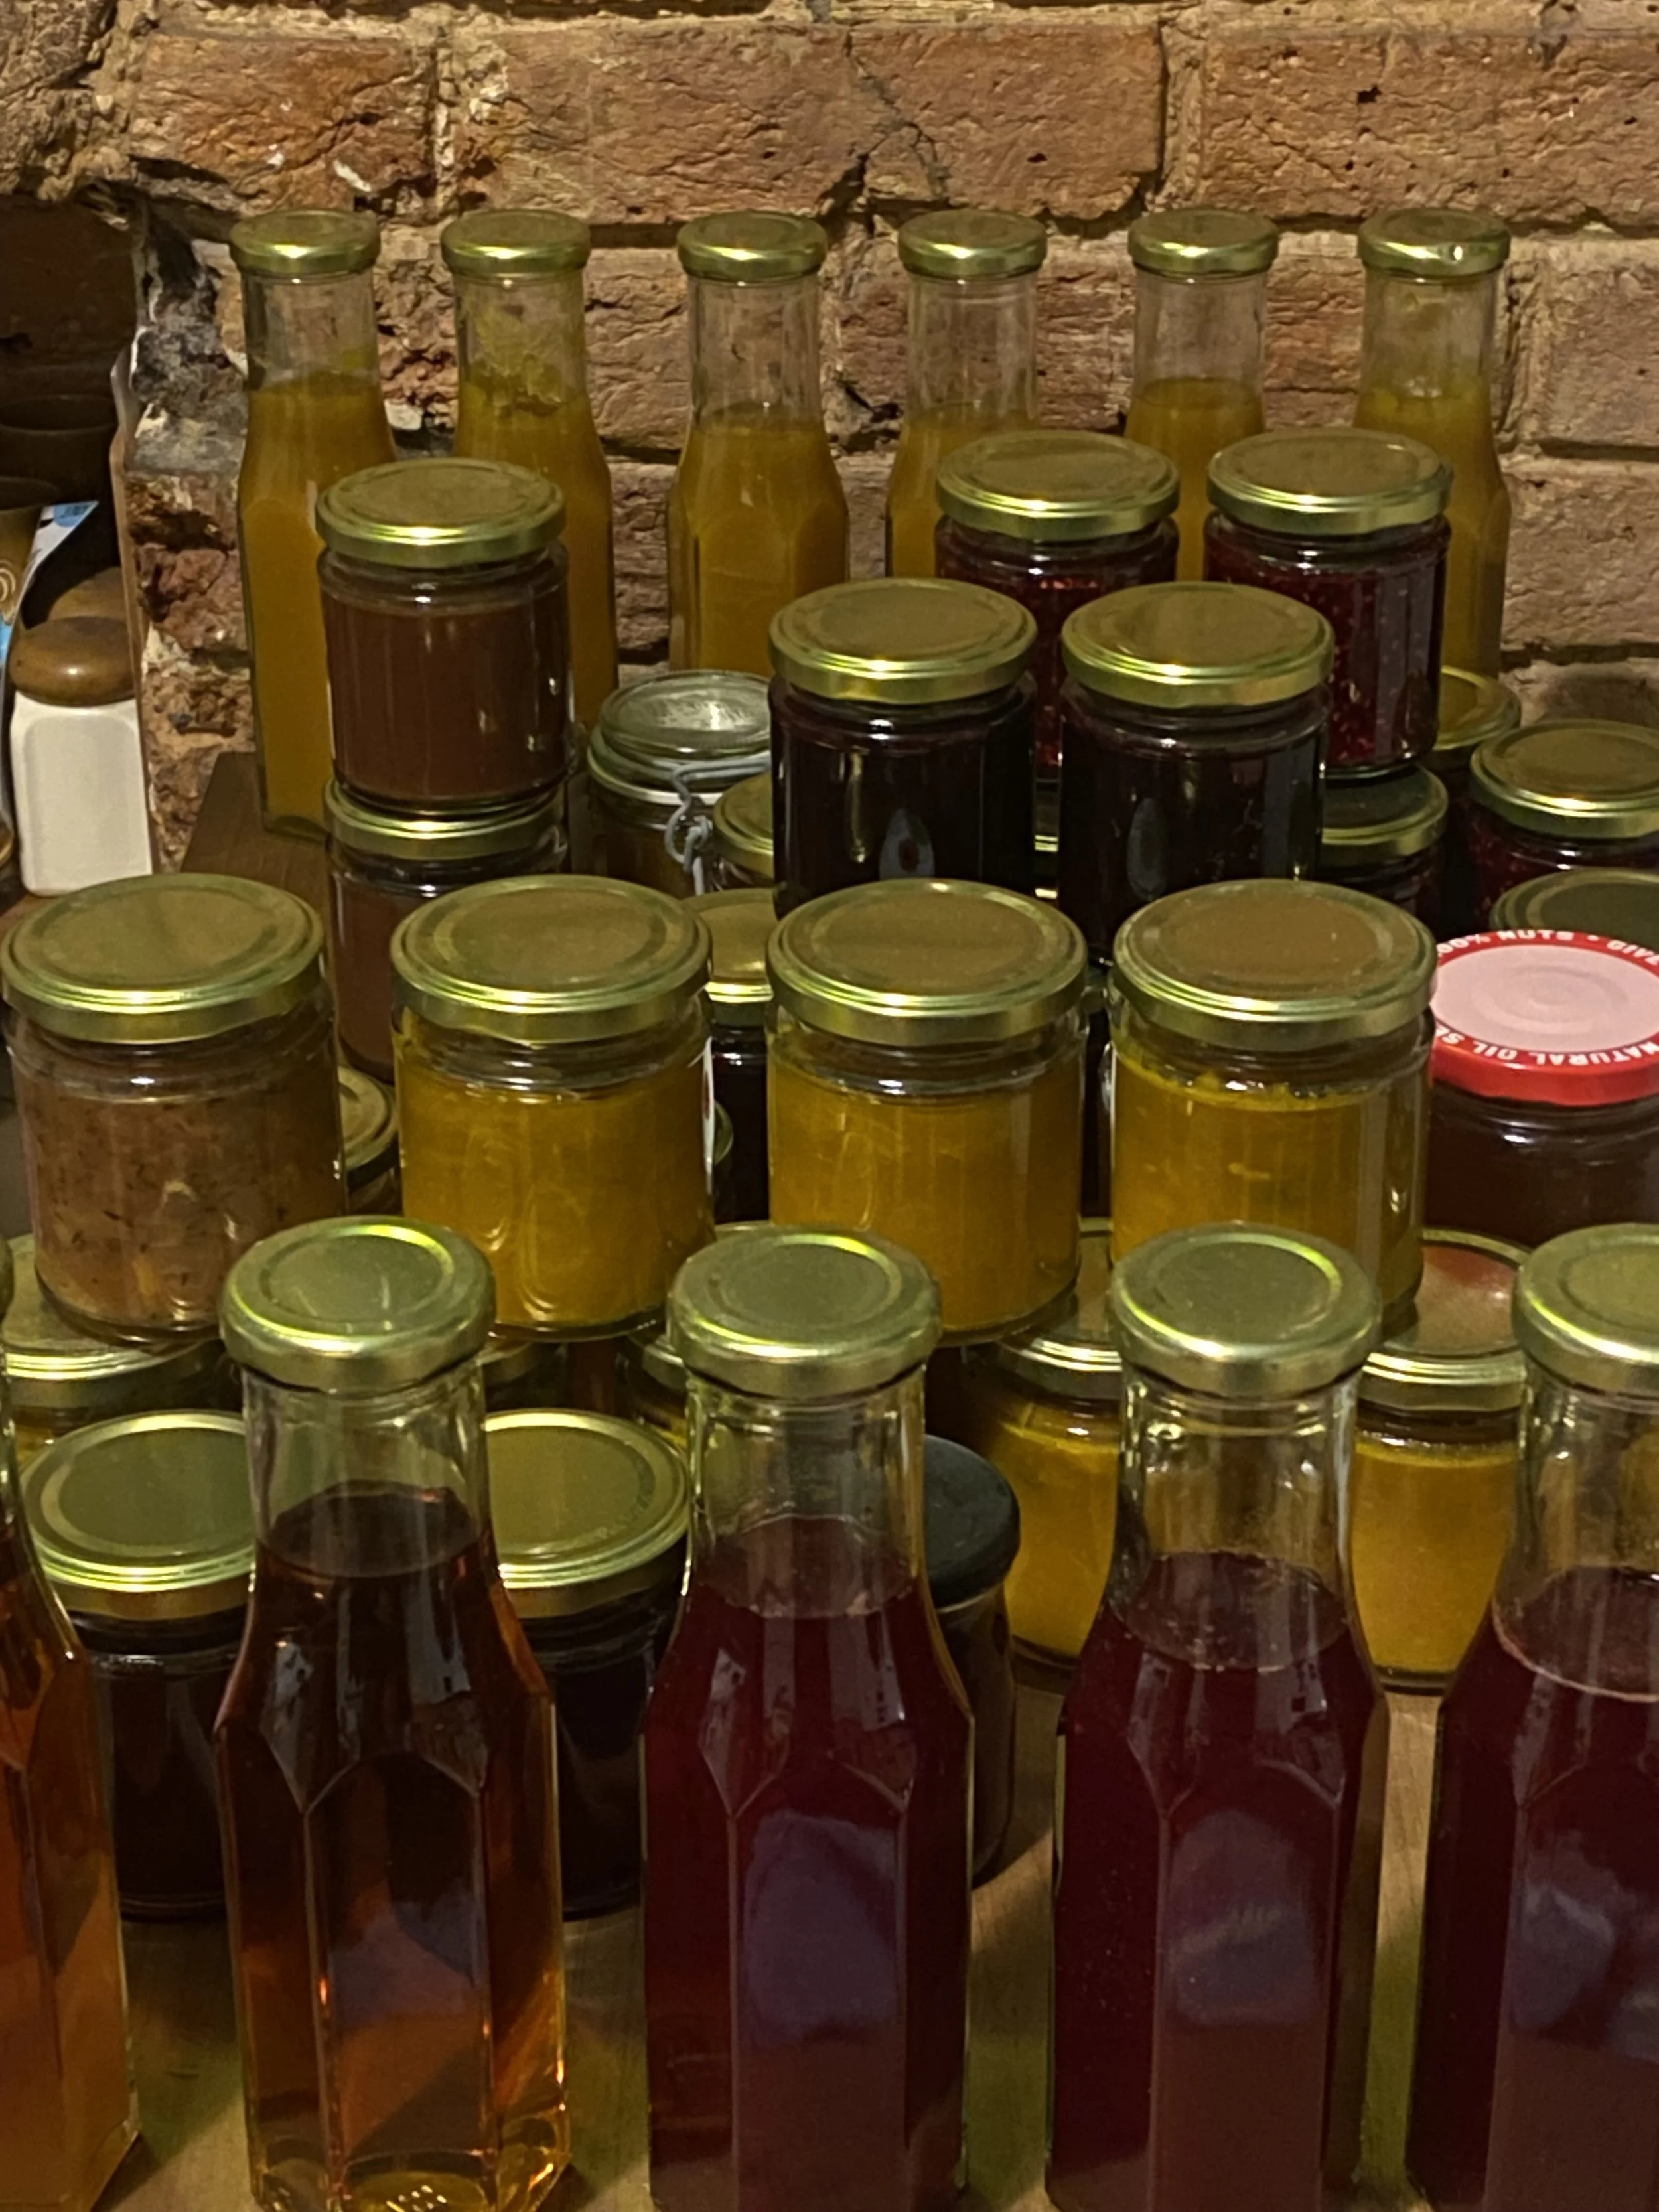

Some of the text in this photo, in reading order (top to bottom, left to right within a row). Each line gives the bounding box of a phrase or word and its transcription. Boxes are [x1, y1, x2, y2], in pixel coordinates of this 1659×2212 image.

[1436, 934, 1491, 958] 00%
[1496, 929, 1574, 941] NUTS
[1472, 1039, 1518, 1061] OIL
[1528, 1041, 1659, 1066] NATURAL
